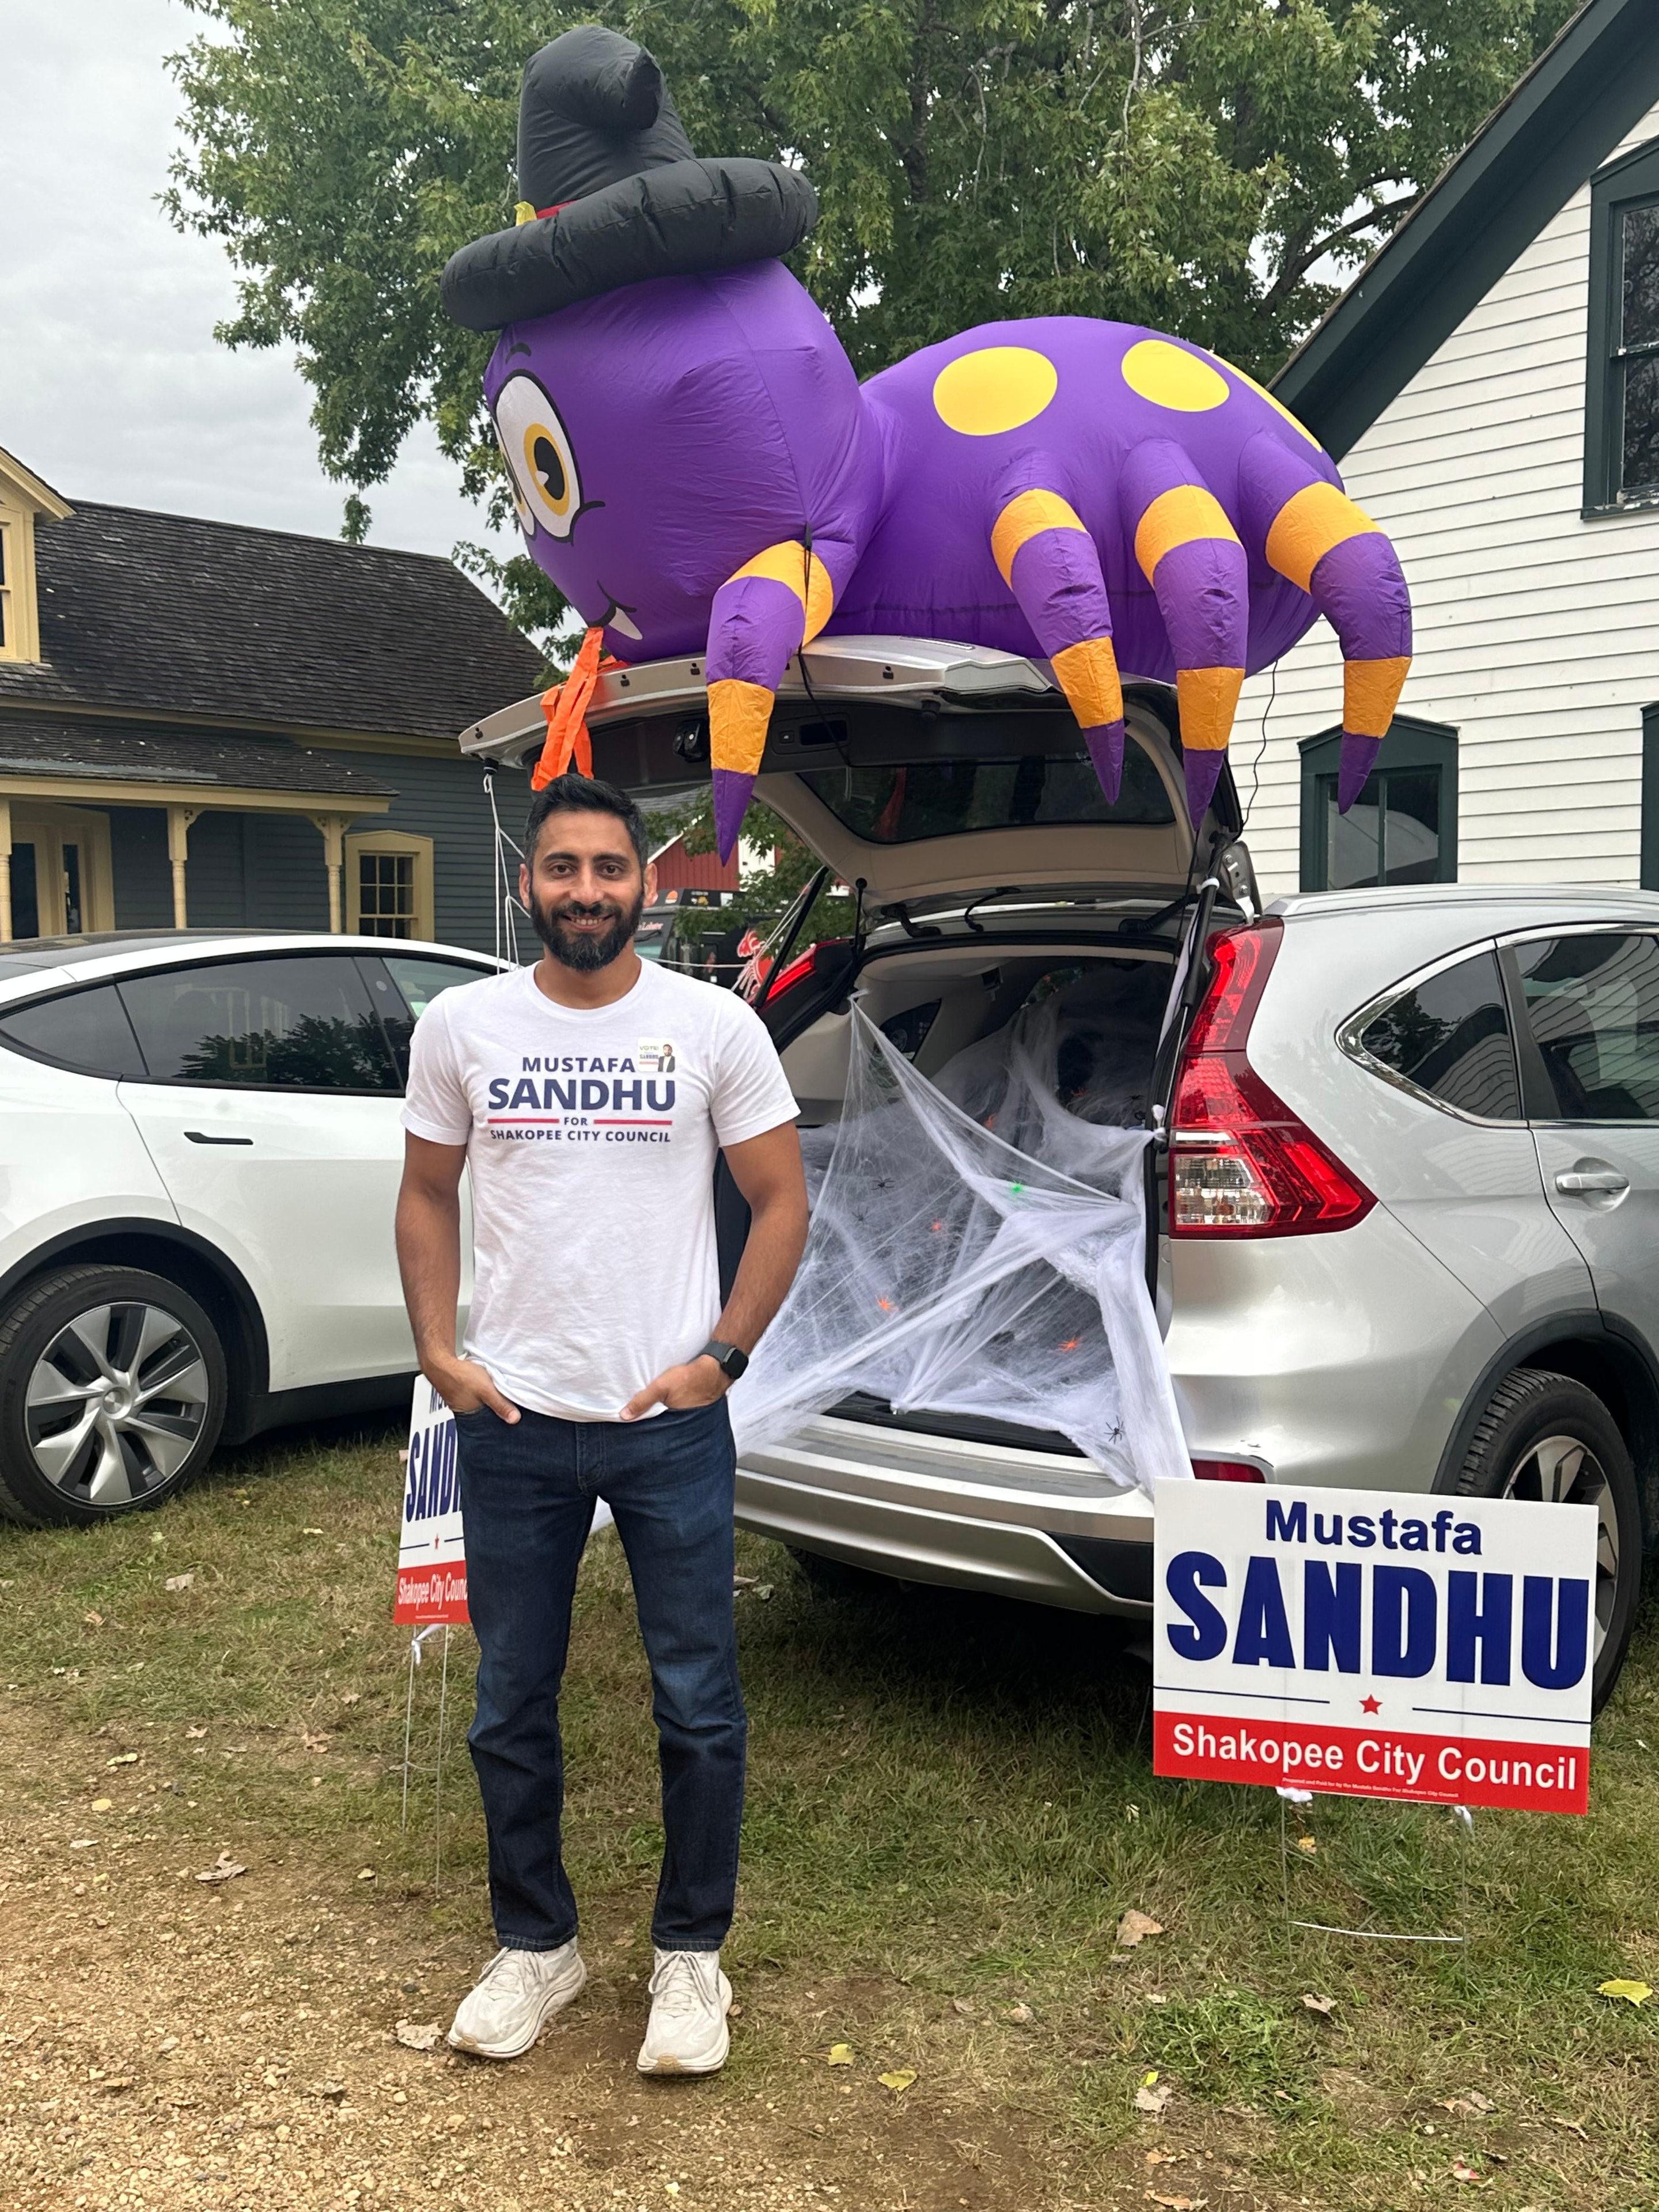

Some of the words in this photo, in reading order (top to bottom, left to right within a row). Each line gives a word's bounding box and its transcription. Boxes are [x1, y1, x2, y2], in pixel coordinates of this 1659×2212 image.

[522, 1057, 635, 1072] MUSTAFA
[488, 1078, 675, 1111] SANDHU
[491, 1130, 562, 1141] SHAKOPEE
[567, 1131, 601, 1141] CITY
[606, 1131, 671, 1142] COUNCIL
[564, 1117, 588, 1126] FOR
[429, 1384, 449, 1414] Mu
[1266, 1499, 1482, 1555] Mustafa
[398, 1577, 429, 1611] Shakopee
[430, 1573, 445, 1611] City
[1166, 1551, 1590, 1690] SANDHU
[1173, 1722, 1344, 1773] Shakopee
[1356, 1738, 1426, 1785] City
[1438, 1747, 1575, 1790] Council
